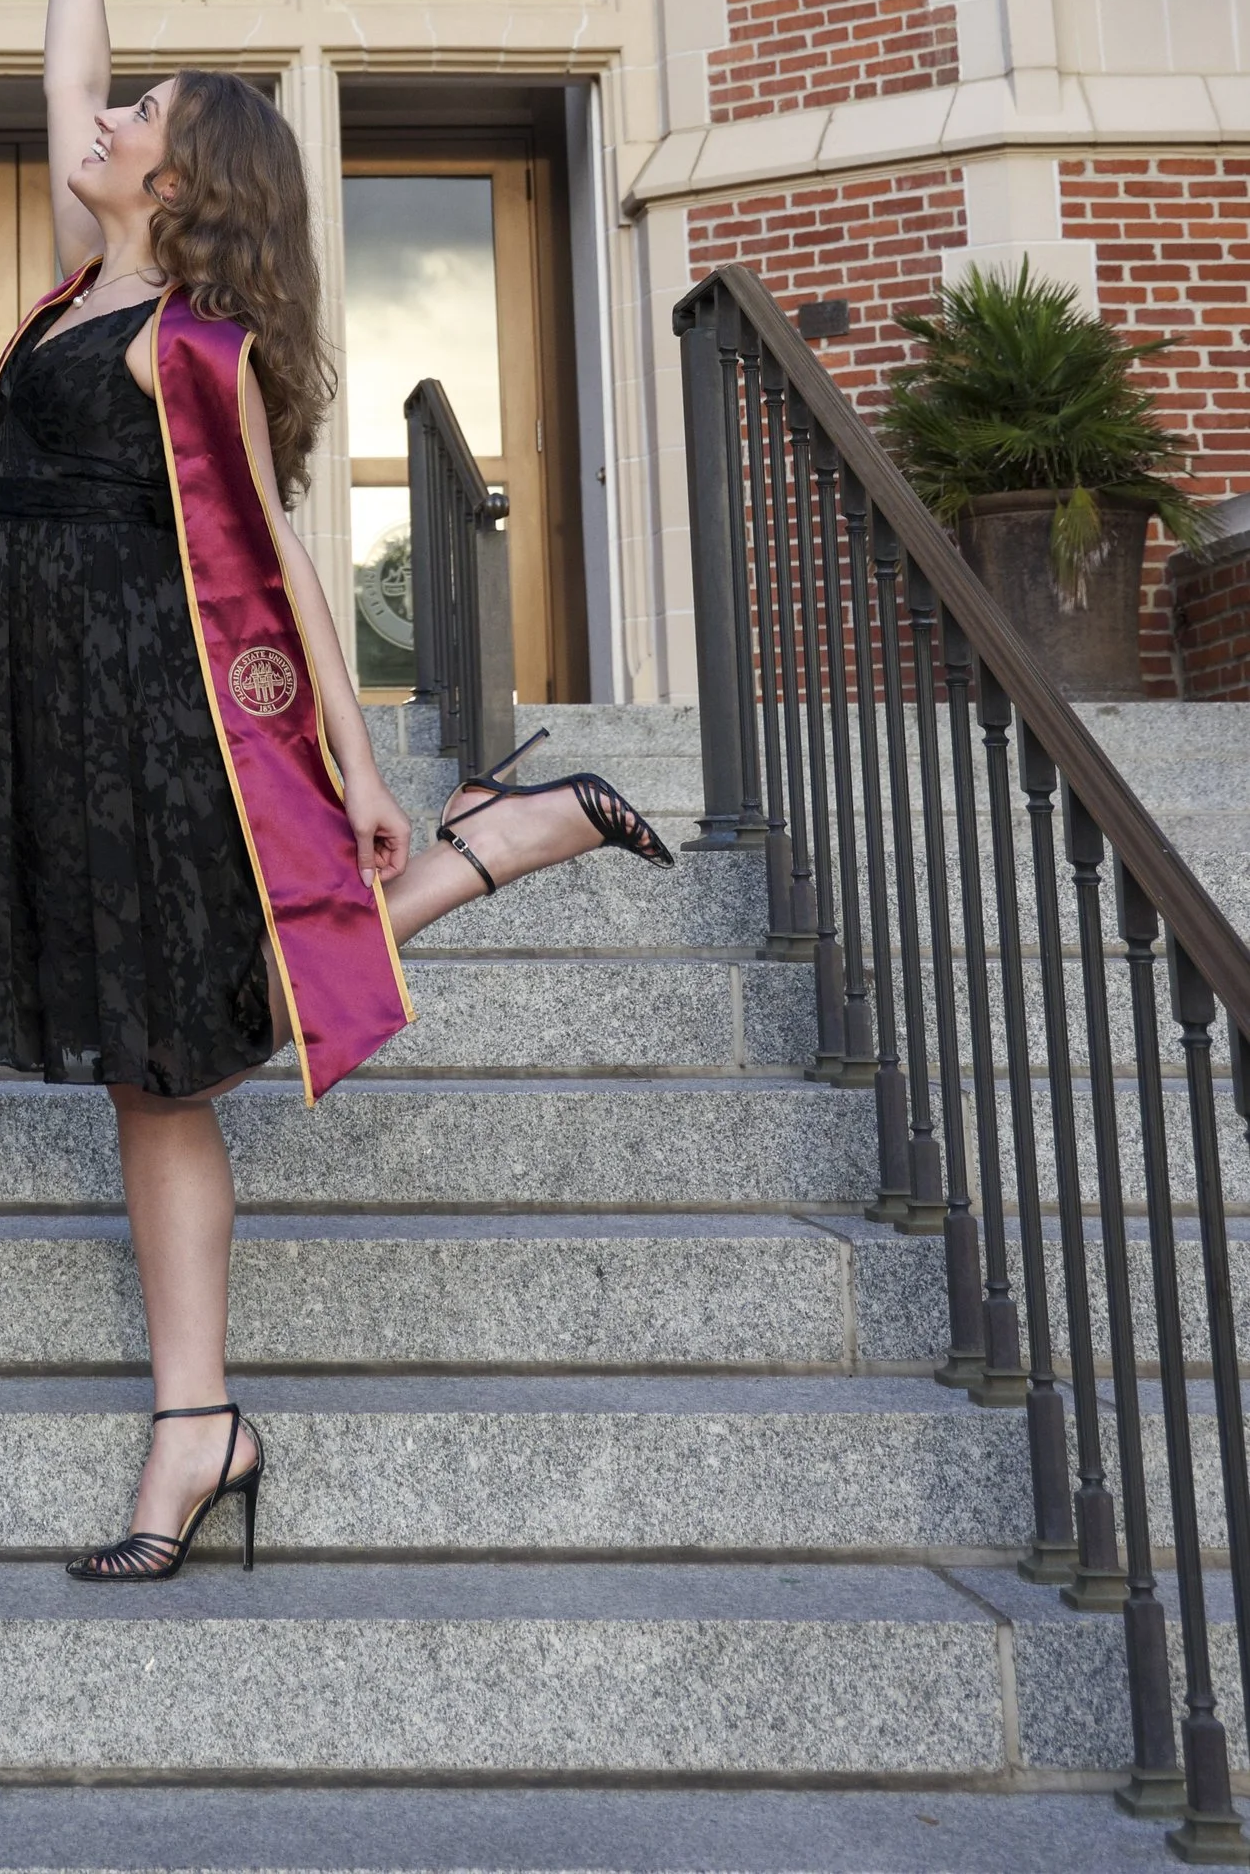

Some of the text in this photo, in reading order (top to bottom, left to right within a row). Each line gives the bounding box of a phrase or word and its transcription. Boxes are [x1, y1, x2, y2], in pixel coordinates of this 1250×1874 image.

[232, 651, 293, 703] FLORIDA STATE UNIVERSITY
